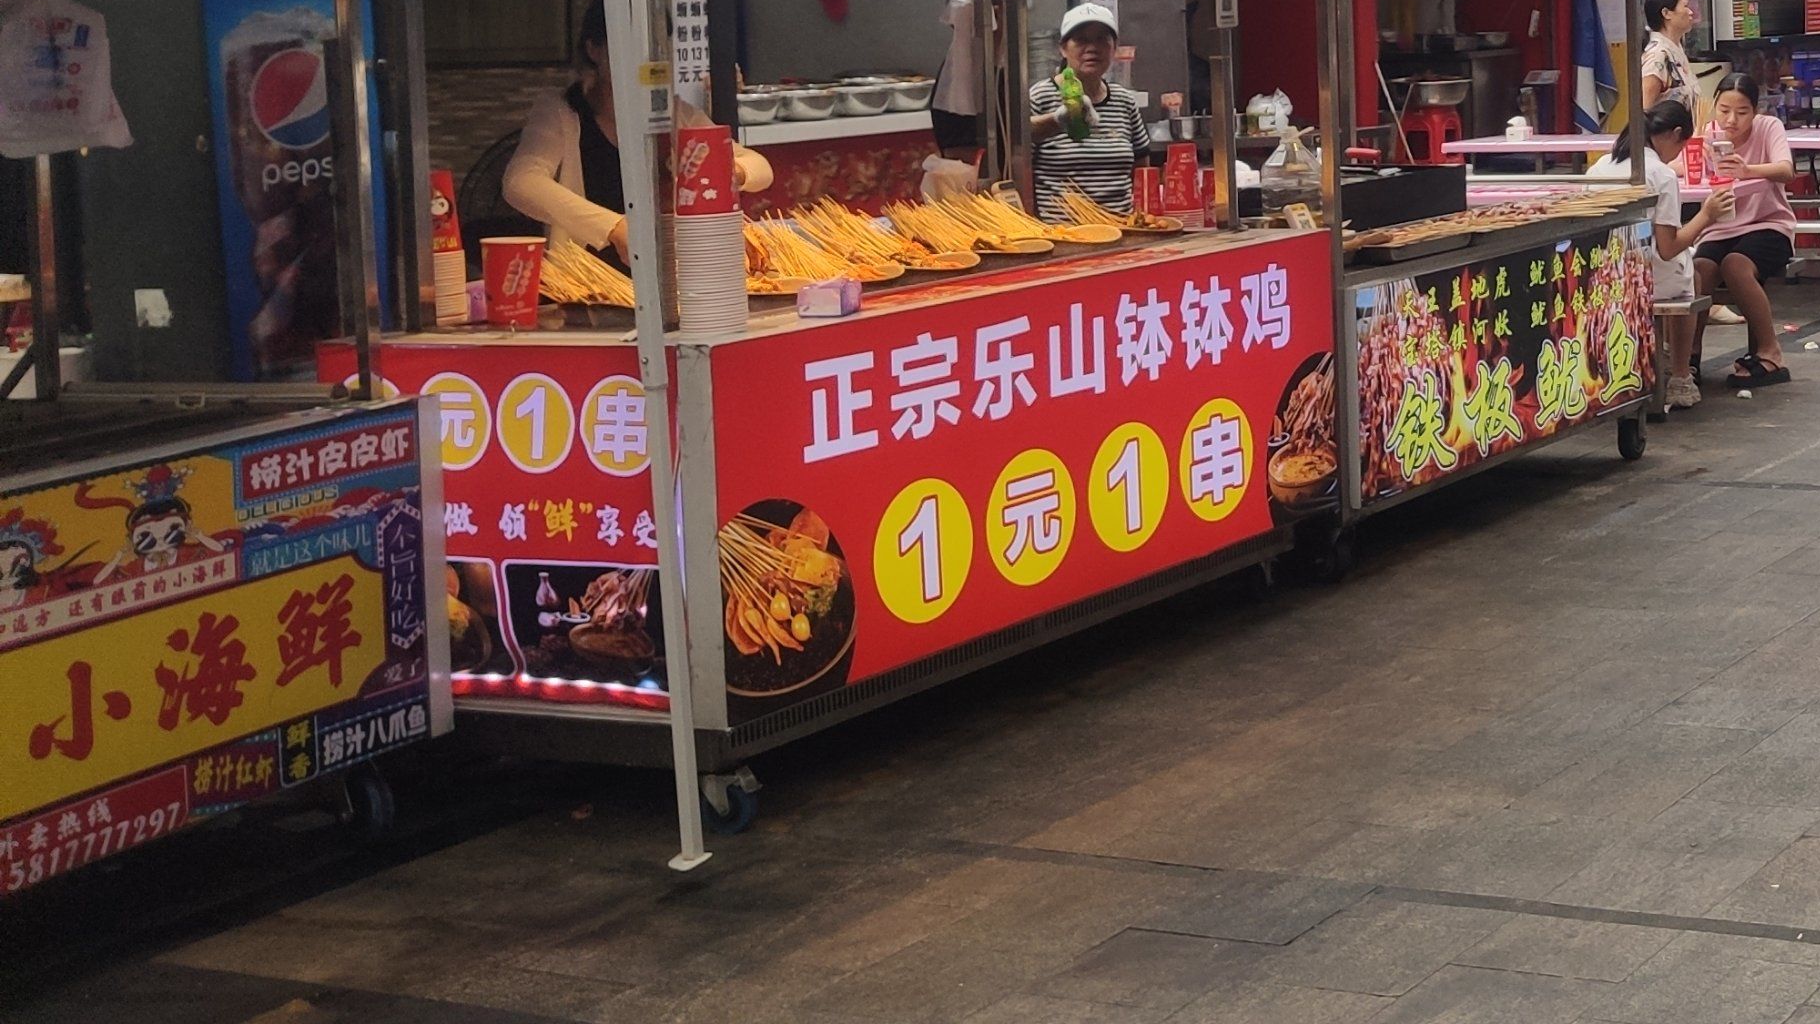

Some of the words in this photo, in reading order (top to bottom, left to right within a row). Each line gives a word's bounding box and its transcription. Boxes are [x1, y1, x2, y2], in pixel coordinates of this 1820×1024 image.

[262, 155, 334, 192] peps
[1401, 266, 1510, 320] 天王盖地虎
[803, 263, 1292, 464] 正宗乐山钵钵鸡
[1403, 313, 1512, 368] 宝塔镇河妖
[1385, 311, 1642, 481] 铁板鱿鱼
[250, 427, 409, 491] 捞汁皮皮虾
[899, 414, 1244, 603] 1元1串
[249, 524, 372, 577] 就是这个味儿
[68, 563, 228, 618] 还有眼前的小海鲜
[29, 573, 363, 762] 小海鲜
[322, 704, 427, 767] 捞汁八爪鱼
[0, 802, 181, 892] 5817777297
